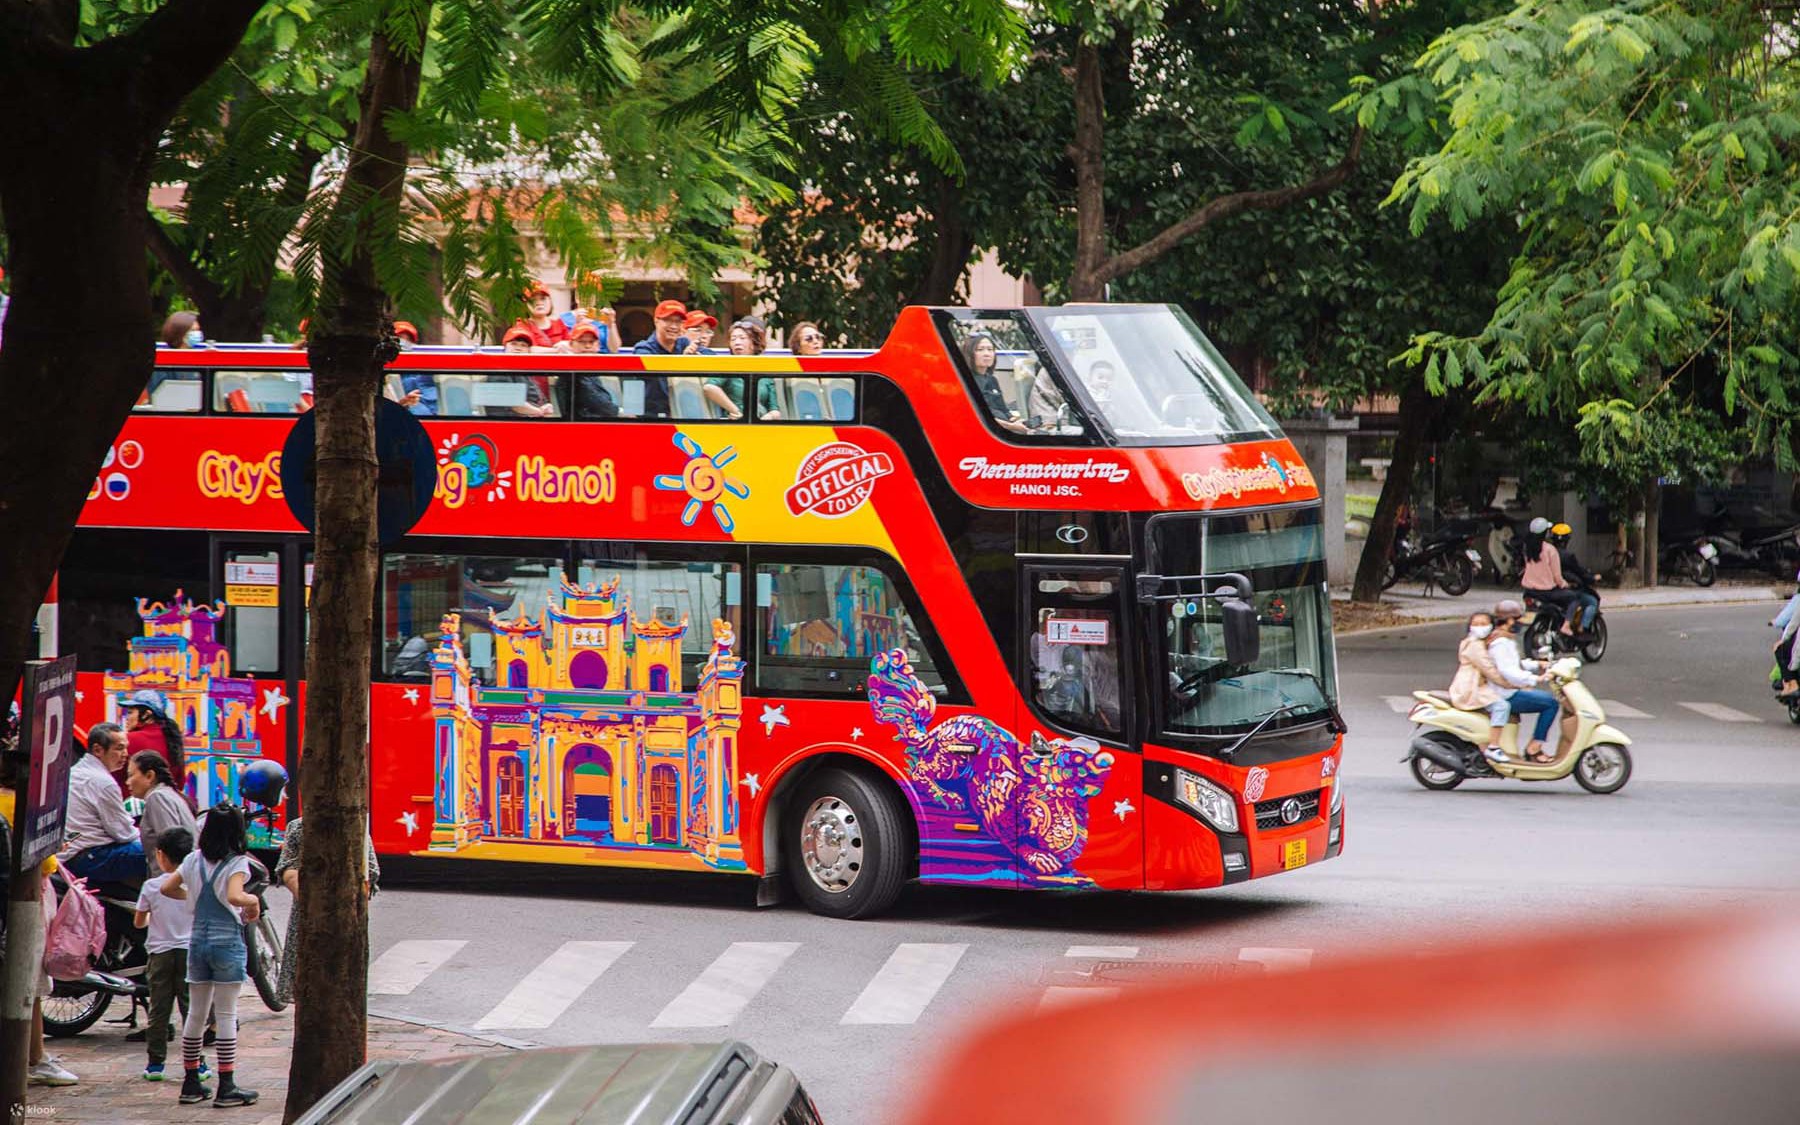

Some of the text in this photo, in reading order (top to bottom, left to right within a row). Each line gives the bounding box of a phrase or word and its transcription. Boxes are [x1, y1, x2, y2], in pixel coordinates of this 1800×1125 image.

[516, 454, 617, 505] Hanoi
[795, 457, 888, 508] OFFICIAL
[958, 456, 1130, 483] Vietnamtourism
[826, 486, 869, 513] TOUR
[1009, 483, 1083, 497] HANOI JSC.
[39, 696, 64, 807] P
